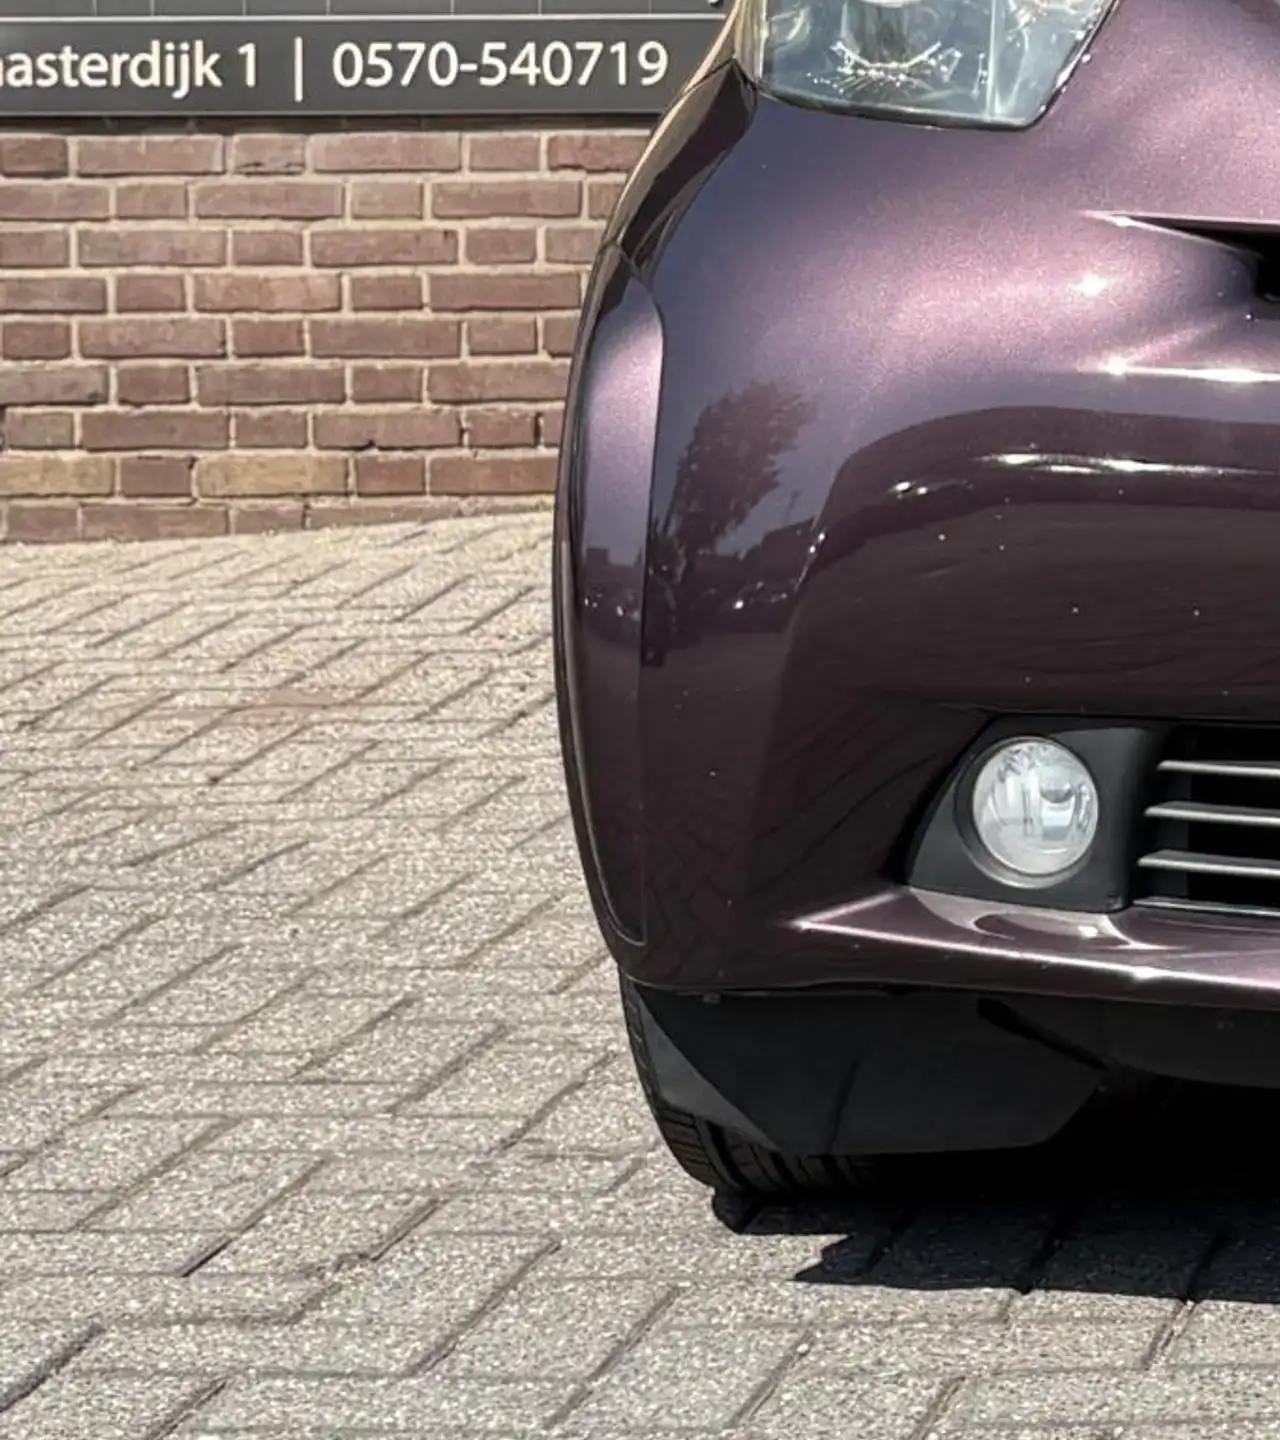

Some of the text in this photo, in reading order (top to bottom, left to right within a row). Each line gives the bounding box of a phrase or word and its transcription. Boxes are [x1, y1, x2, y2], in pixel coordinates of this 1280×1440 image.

[0, 39, 222, 99] asterdijk
[237, 43, 257, 87] 1
[332, 42, 669, 88] 0570-540719
